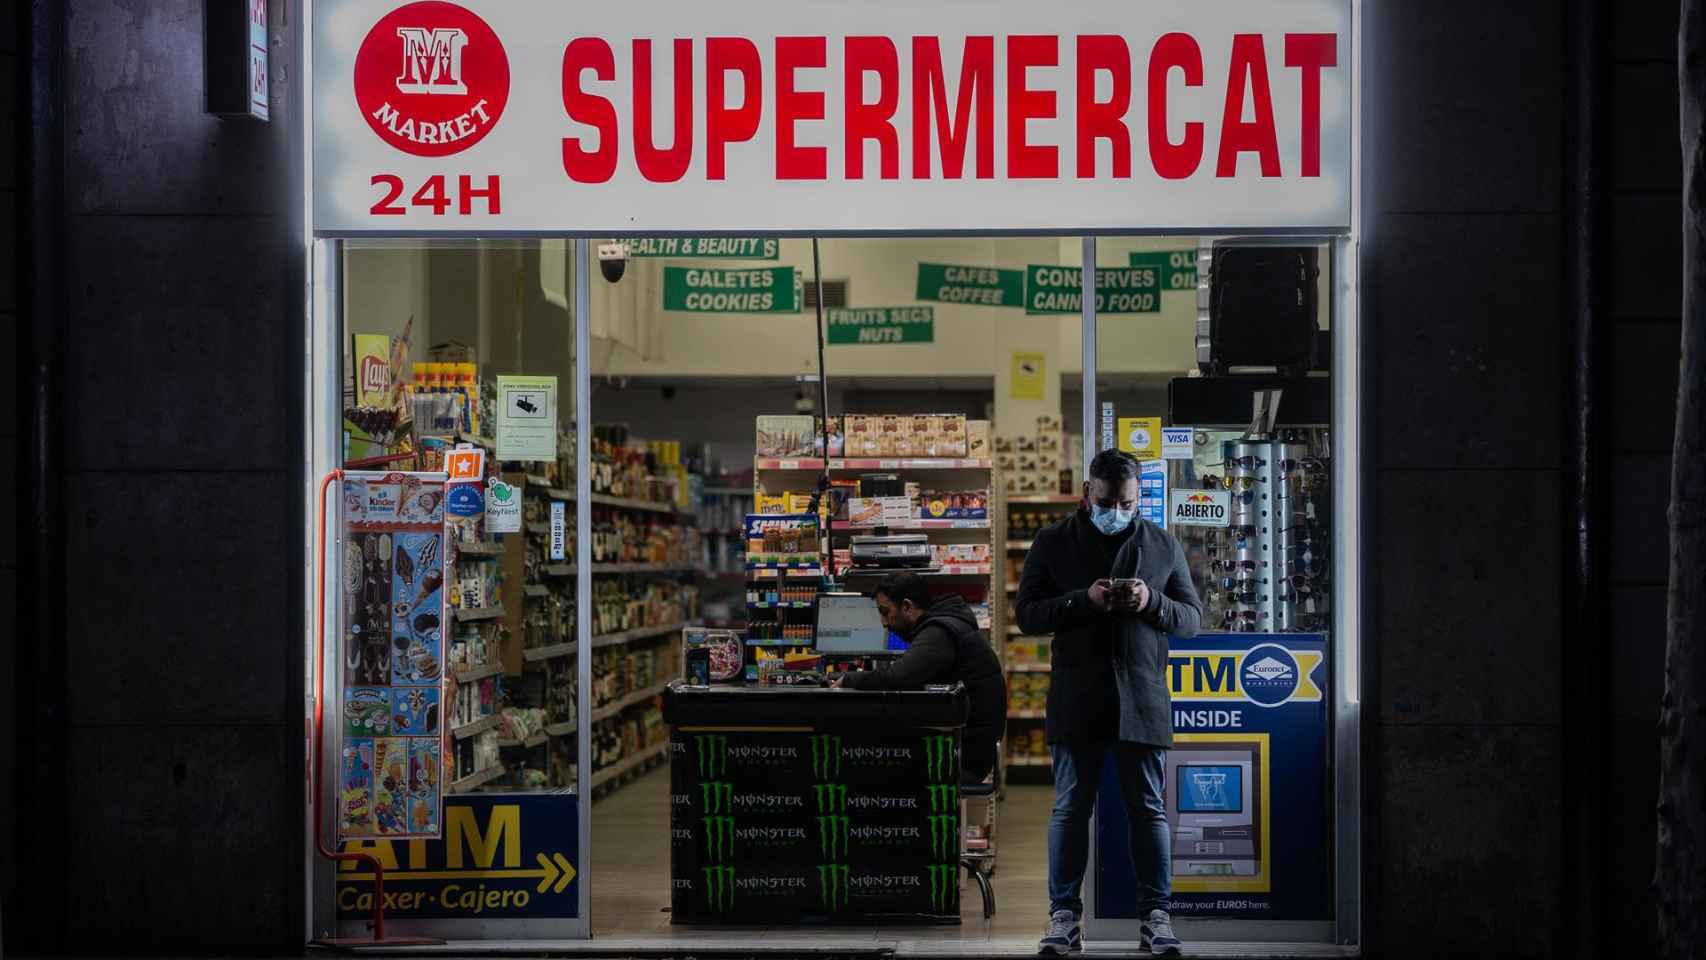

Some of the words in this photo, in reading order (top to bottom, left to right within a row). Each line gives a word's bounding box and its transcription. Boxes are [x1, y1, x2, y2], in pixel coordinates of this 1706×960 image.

[396, 27, 468, 95] M
[562, 32, 1338, 184] SUPERMERCAT
[372, 99, 491, 145] MARKET
[369, 174, 502, 216] 24H
[697, 238, 759, 255] BEAUTY
[685, 271, 774, 288] GALETES
[945, 267, 999, 285] CAFES
[685, 292, 774, 310] COOKIES
[938, 286, 1003, 305] COFFEE
[1033, 291, 1105, 310] CANND
[1107, 293, 1154, 311] FOOD
[829, 309, 886, 325] FRUITS
[890, 308, 932, 324] SECS
[858, 327, 903, 342] NUTS
[1167, 434, 1189, 443] VISA
[1176, 503, 1224, 518] ABIERTO
[1168, 657, 1236, 693] TM
[1254, 664, 1285, 673] Euronet
[1174, 710, 1242, 728] INSIDE
[728, 746, 799, 759] MONSTER
[842, 747, 912, 759] MONSTER
[732, 794, 803, 807] MONSTER
[847, 795, 918, 808] MONSTER
[736, 826, 806, 840] MONSTER
[850, 826, 920, 839] MONSTER
[736, 876, 806, 890] MONSTER
[850, 875, 921, 888] MONSTER
[1195, 901, 1216, 912] your
[1216, 900, 1248, 910] EUROS
